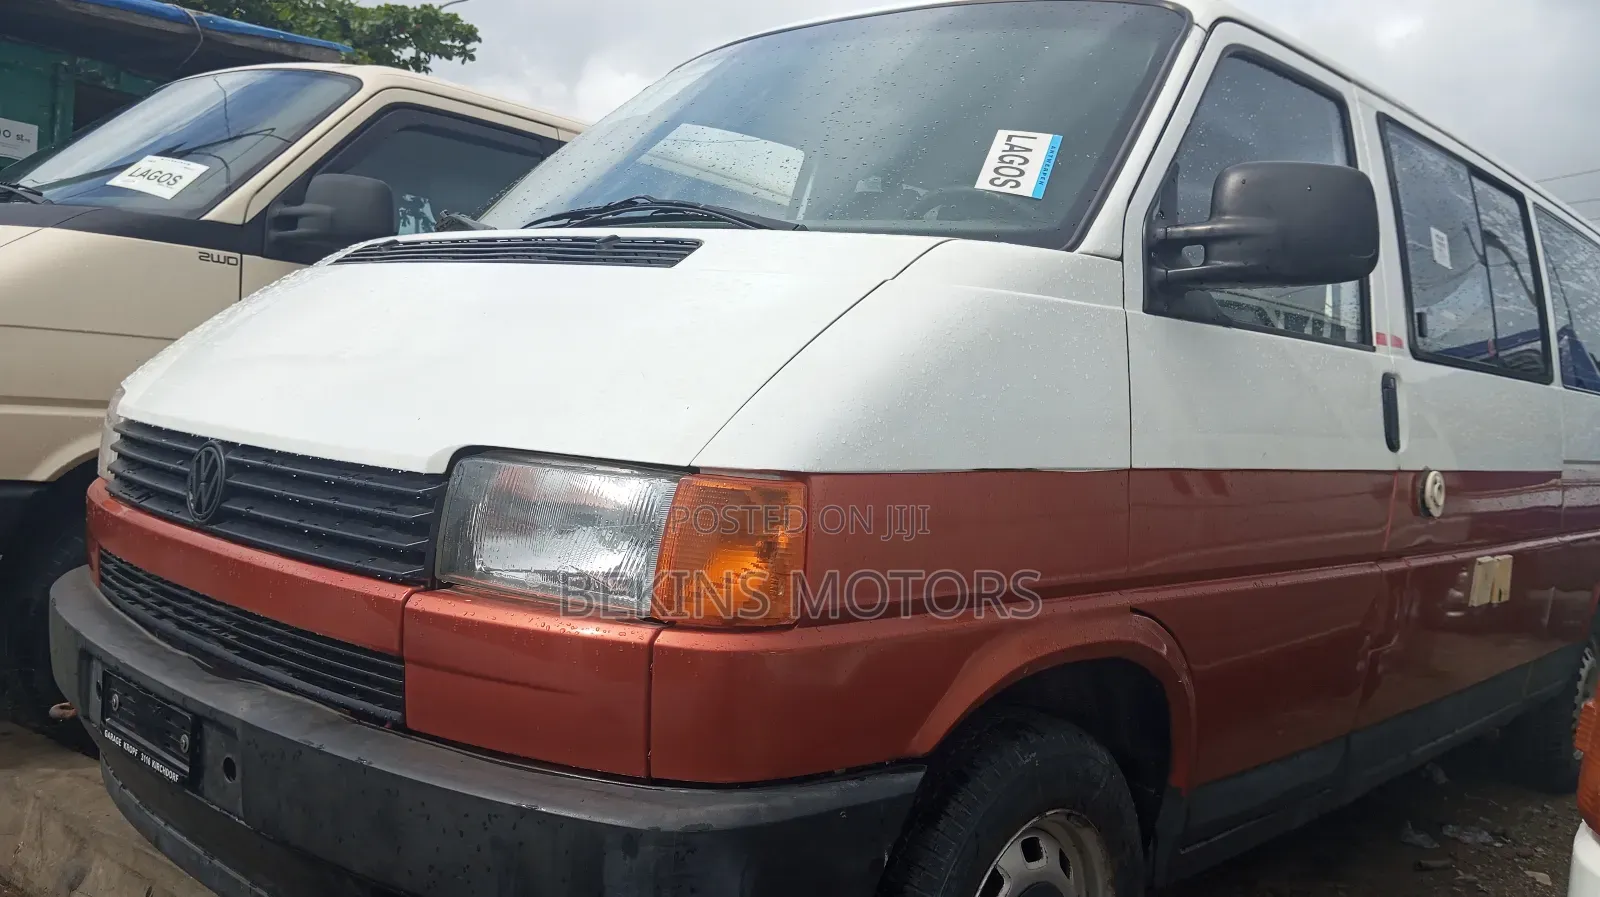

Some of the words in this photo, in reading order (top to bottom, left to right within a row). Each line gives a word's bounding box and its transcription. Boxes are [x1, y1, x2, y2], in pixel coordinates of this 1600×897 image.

[128, 167, 183, 186] LAGOS
[988, 134, 1037, 189] LAGOS
[1038, 145, 1056, 186] ANTWERPEN
[198, 251, 239, 266] 2WD
[104, 729, 122, 747] GARAGE
[123, 741, 139, 757] KROPF
[151, 760, 179, 782] KIRCHDORF
